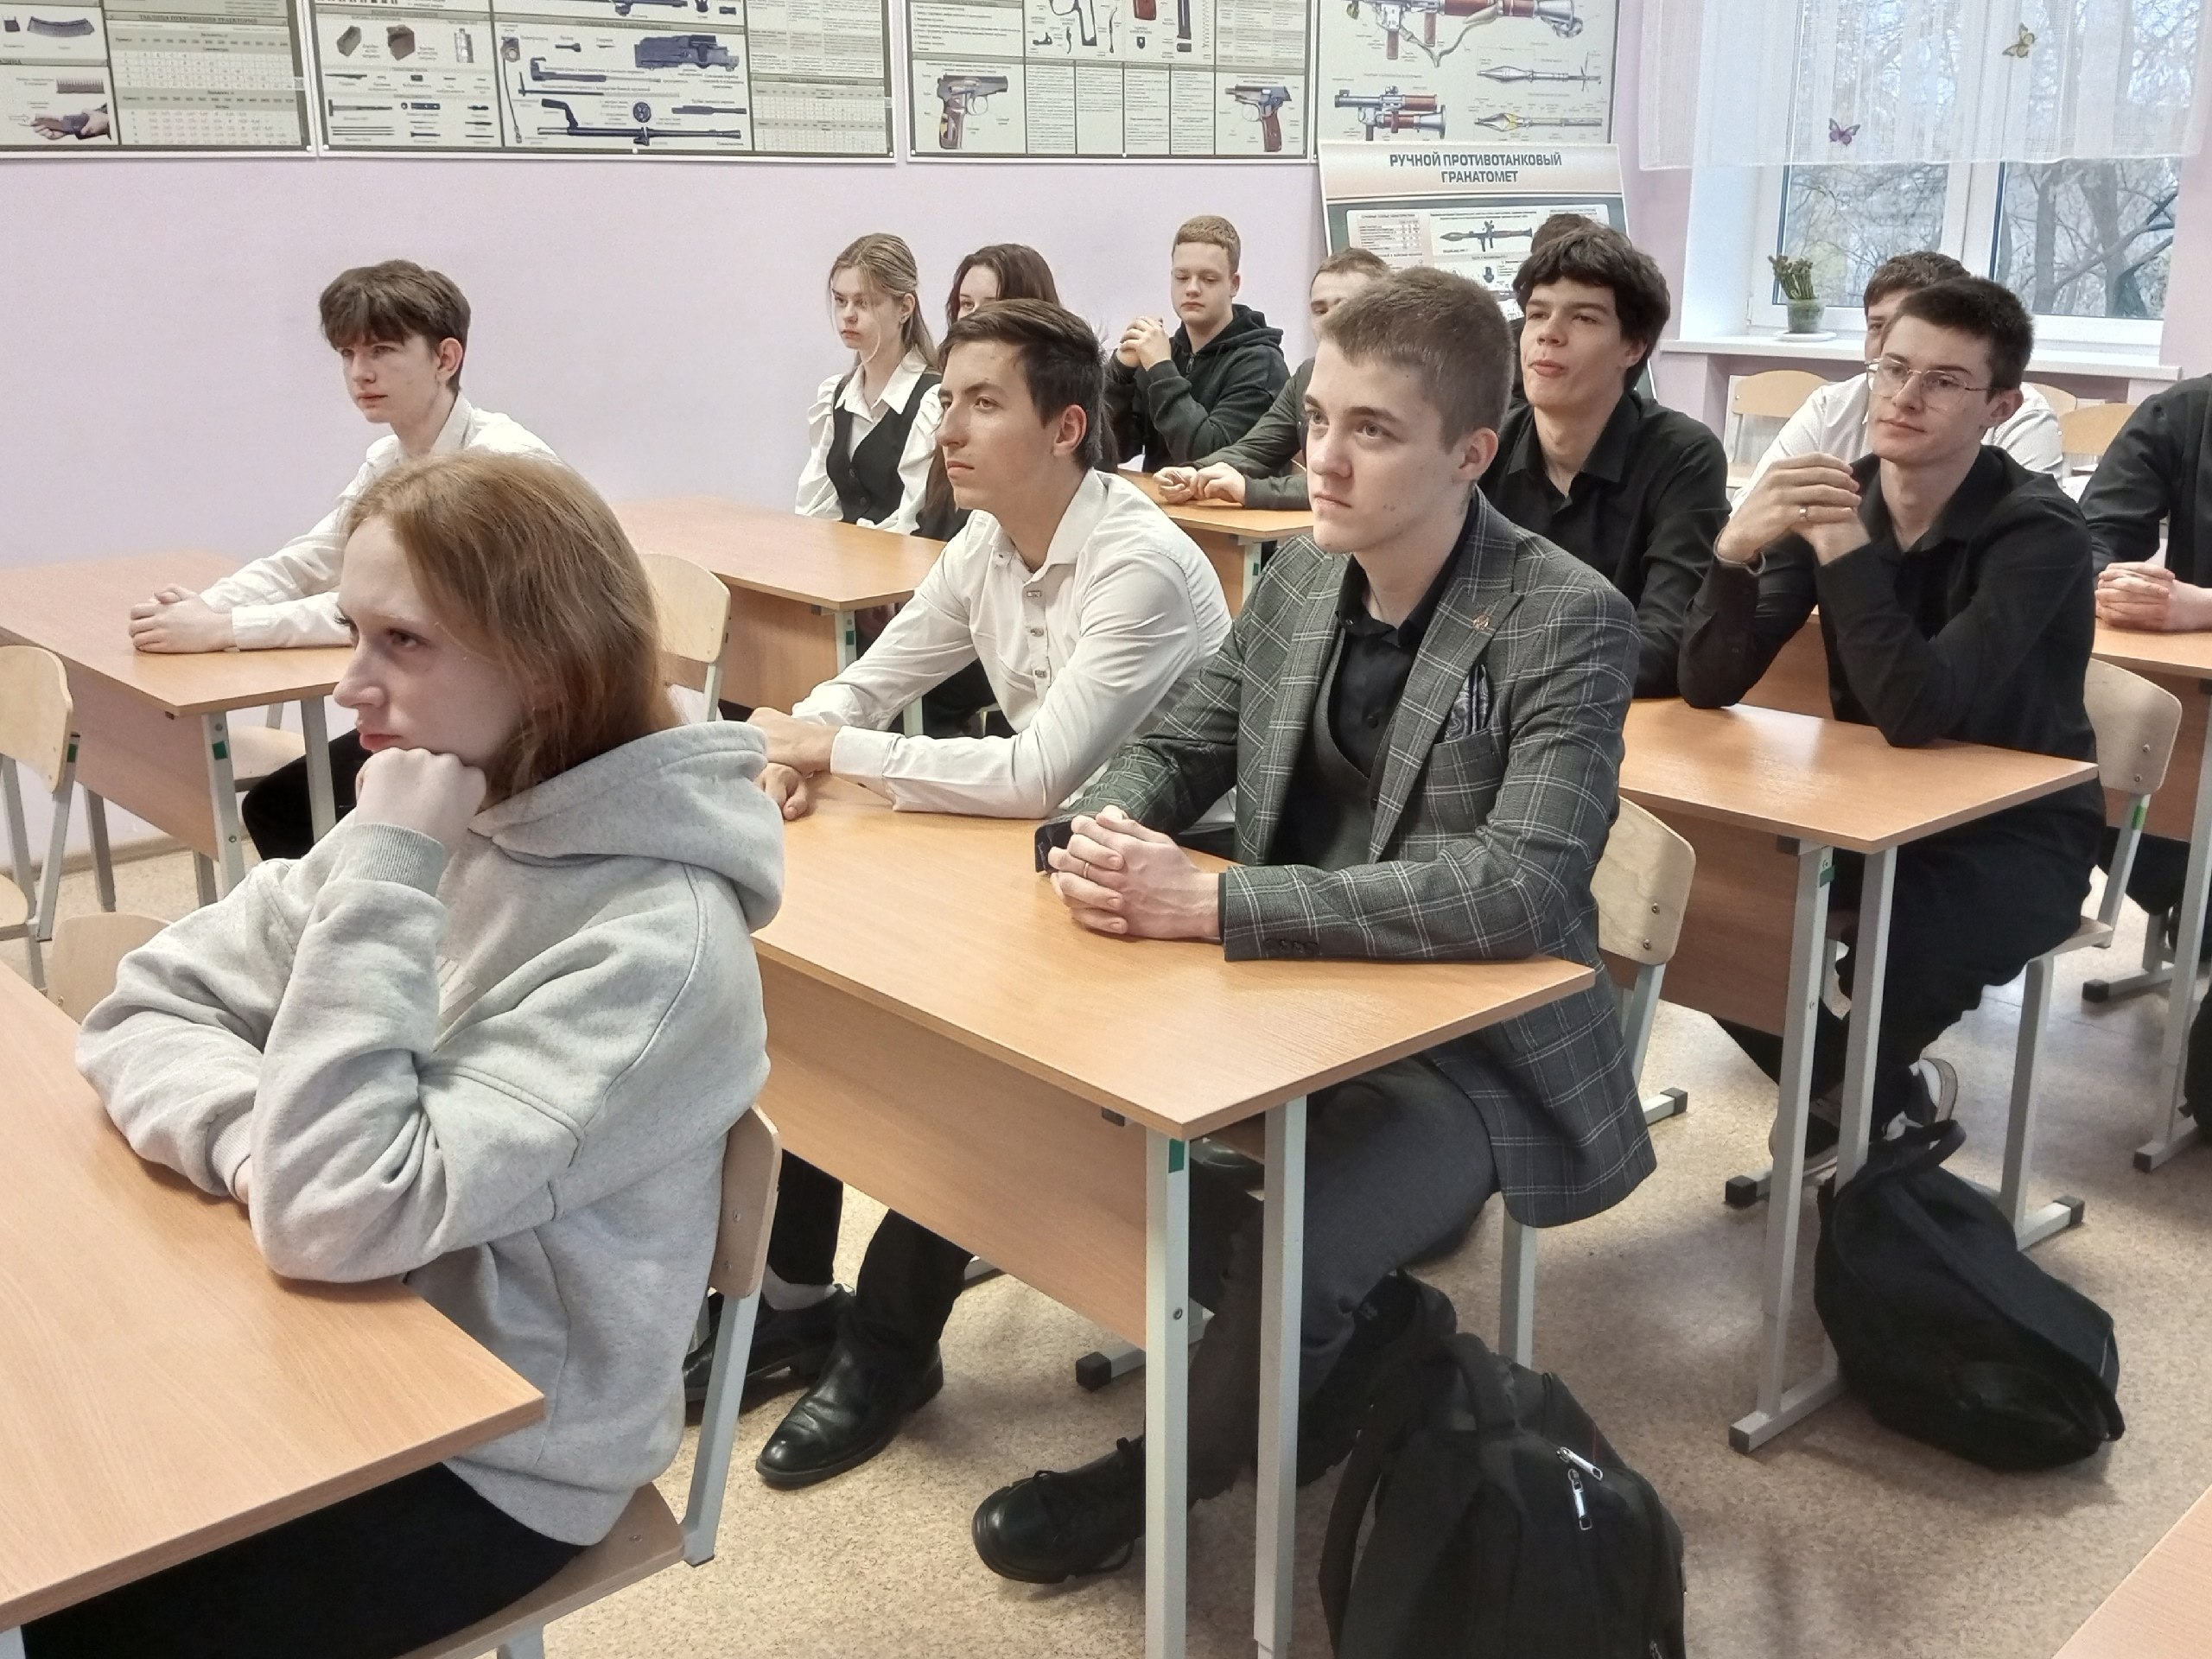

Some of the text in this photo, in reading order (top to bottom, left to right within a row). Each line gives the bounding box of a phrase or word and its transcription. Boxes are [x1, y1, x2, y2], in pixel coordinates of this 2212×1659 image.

[1390, 151, 1562, 167] РУЧНОЙ ПРОТИВОТАНКОВЫЙ
[1441, 171, 1518, 183] ГРАНАТОМЕТ
